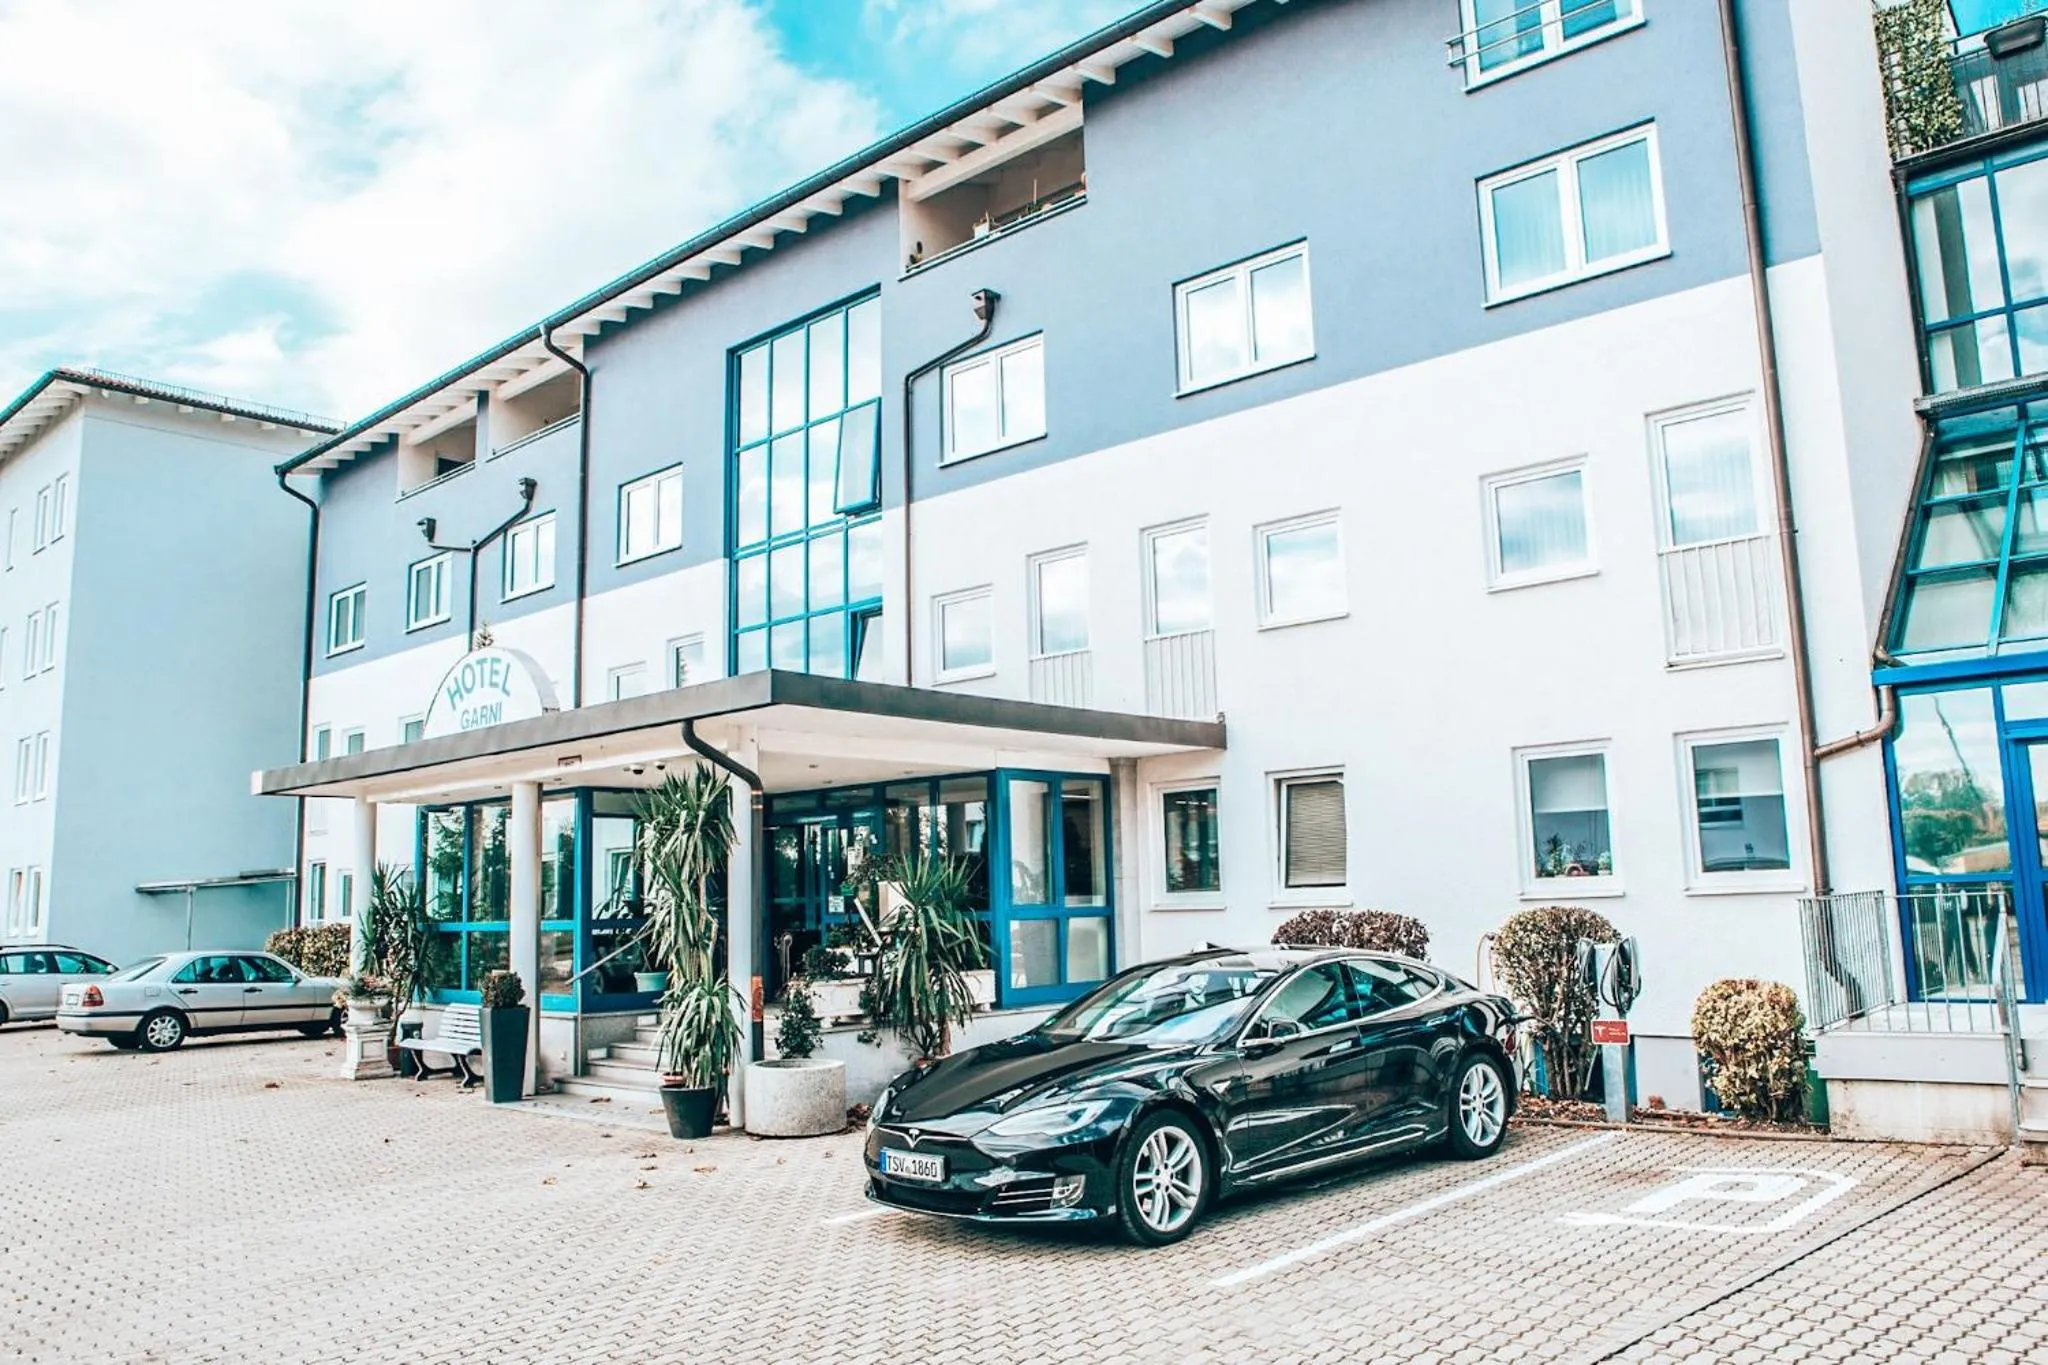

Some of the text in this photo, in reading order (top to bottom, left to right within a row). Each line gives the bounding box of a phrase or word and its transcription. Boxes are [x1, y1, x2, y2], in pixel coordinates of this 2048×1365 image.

[447, 657, 510, 711] HOTEL
[461, 702, 502, 729] GARNI
[887, 1155, 938, 1178] TSV 1860
